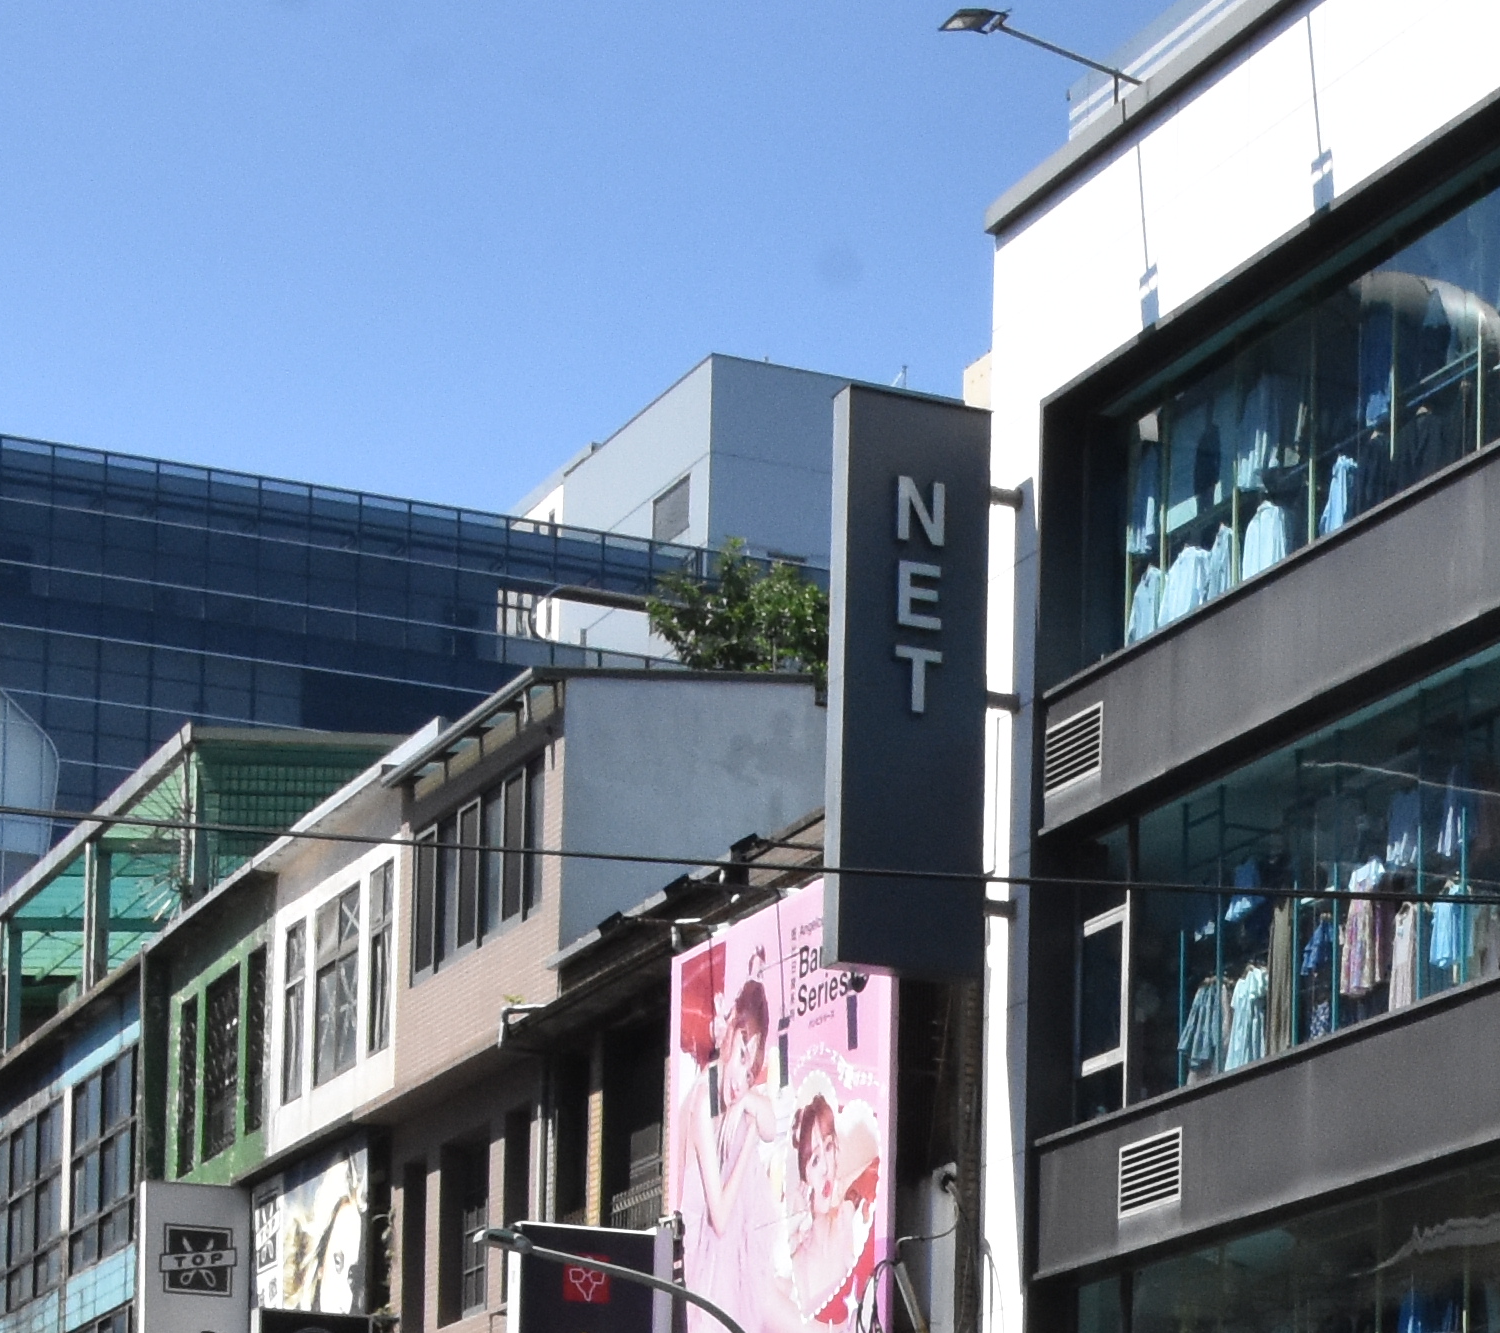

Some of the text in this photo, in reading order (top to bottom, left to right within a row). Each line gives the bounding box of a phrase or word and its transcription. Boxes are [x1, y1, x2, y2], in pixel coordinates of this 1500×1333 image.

[895, 475, 947, 714] NET
[799, 944, 824, 979] Ba
[797, 971, 849, 1017] Series
[174, 1252, 224, 1267] TOP
